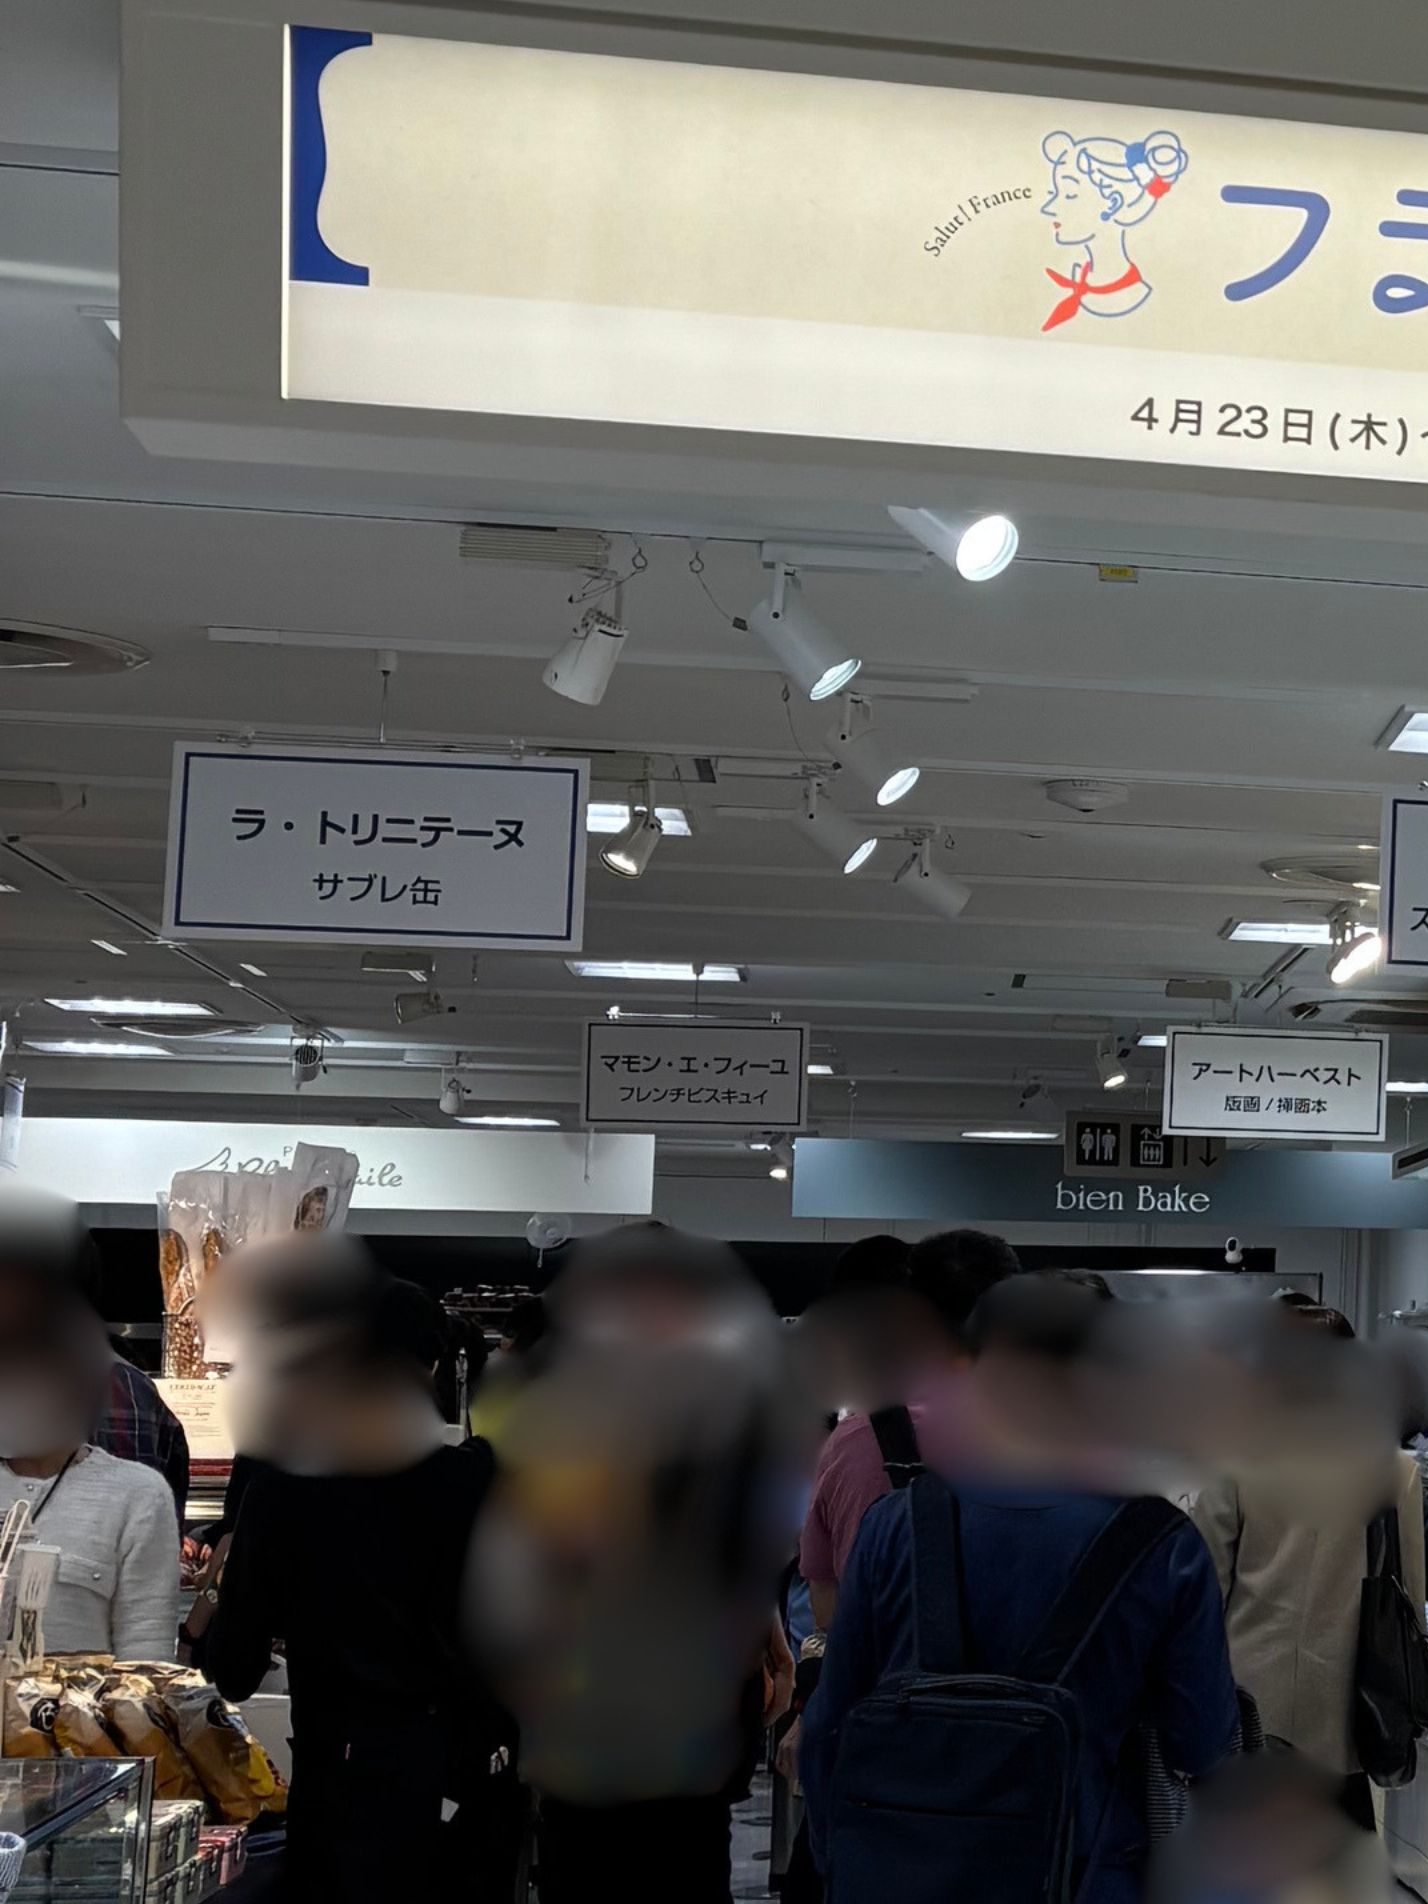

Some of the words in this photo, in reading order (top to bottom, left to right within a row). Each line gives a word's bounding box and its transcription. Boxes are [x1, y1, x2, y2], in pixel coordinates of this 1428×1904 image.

[968, 186, 1032, 214] France
[231, 808, 525, 851] ラ・トリニテーヌ
[312, 872, 442, 907] サブレ缶
[599, 1054, 790, 1077] マモン・エ・フィーユ
[1191, 1062, 1363, 1088] アートハーベスト
[619, 1086, 769, 1106] フレンチビスキュイ
[1055, 1181, 1125, 1211] bien
[1136, 1183, 1211, 1213] Bake
